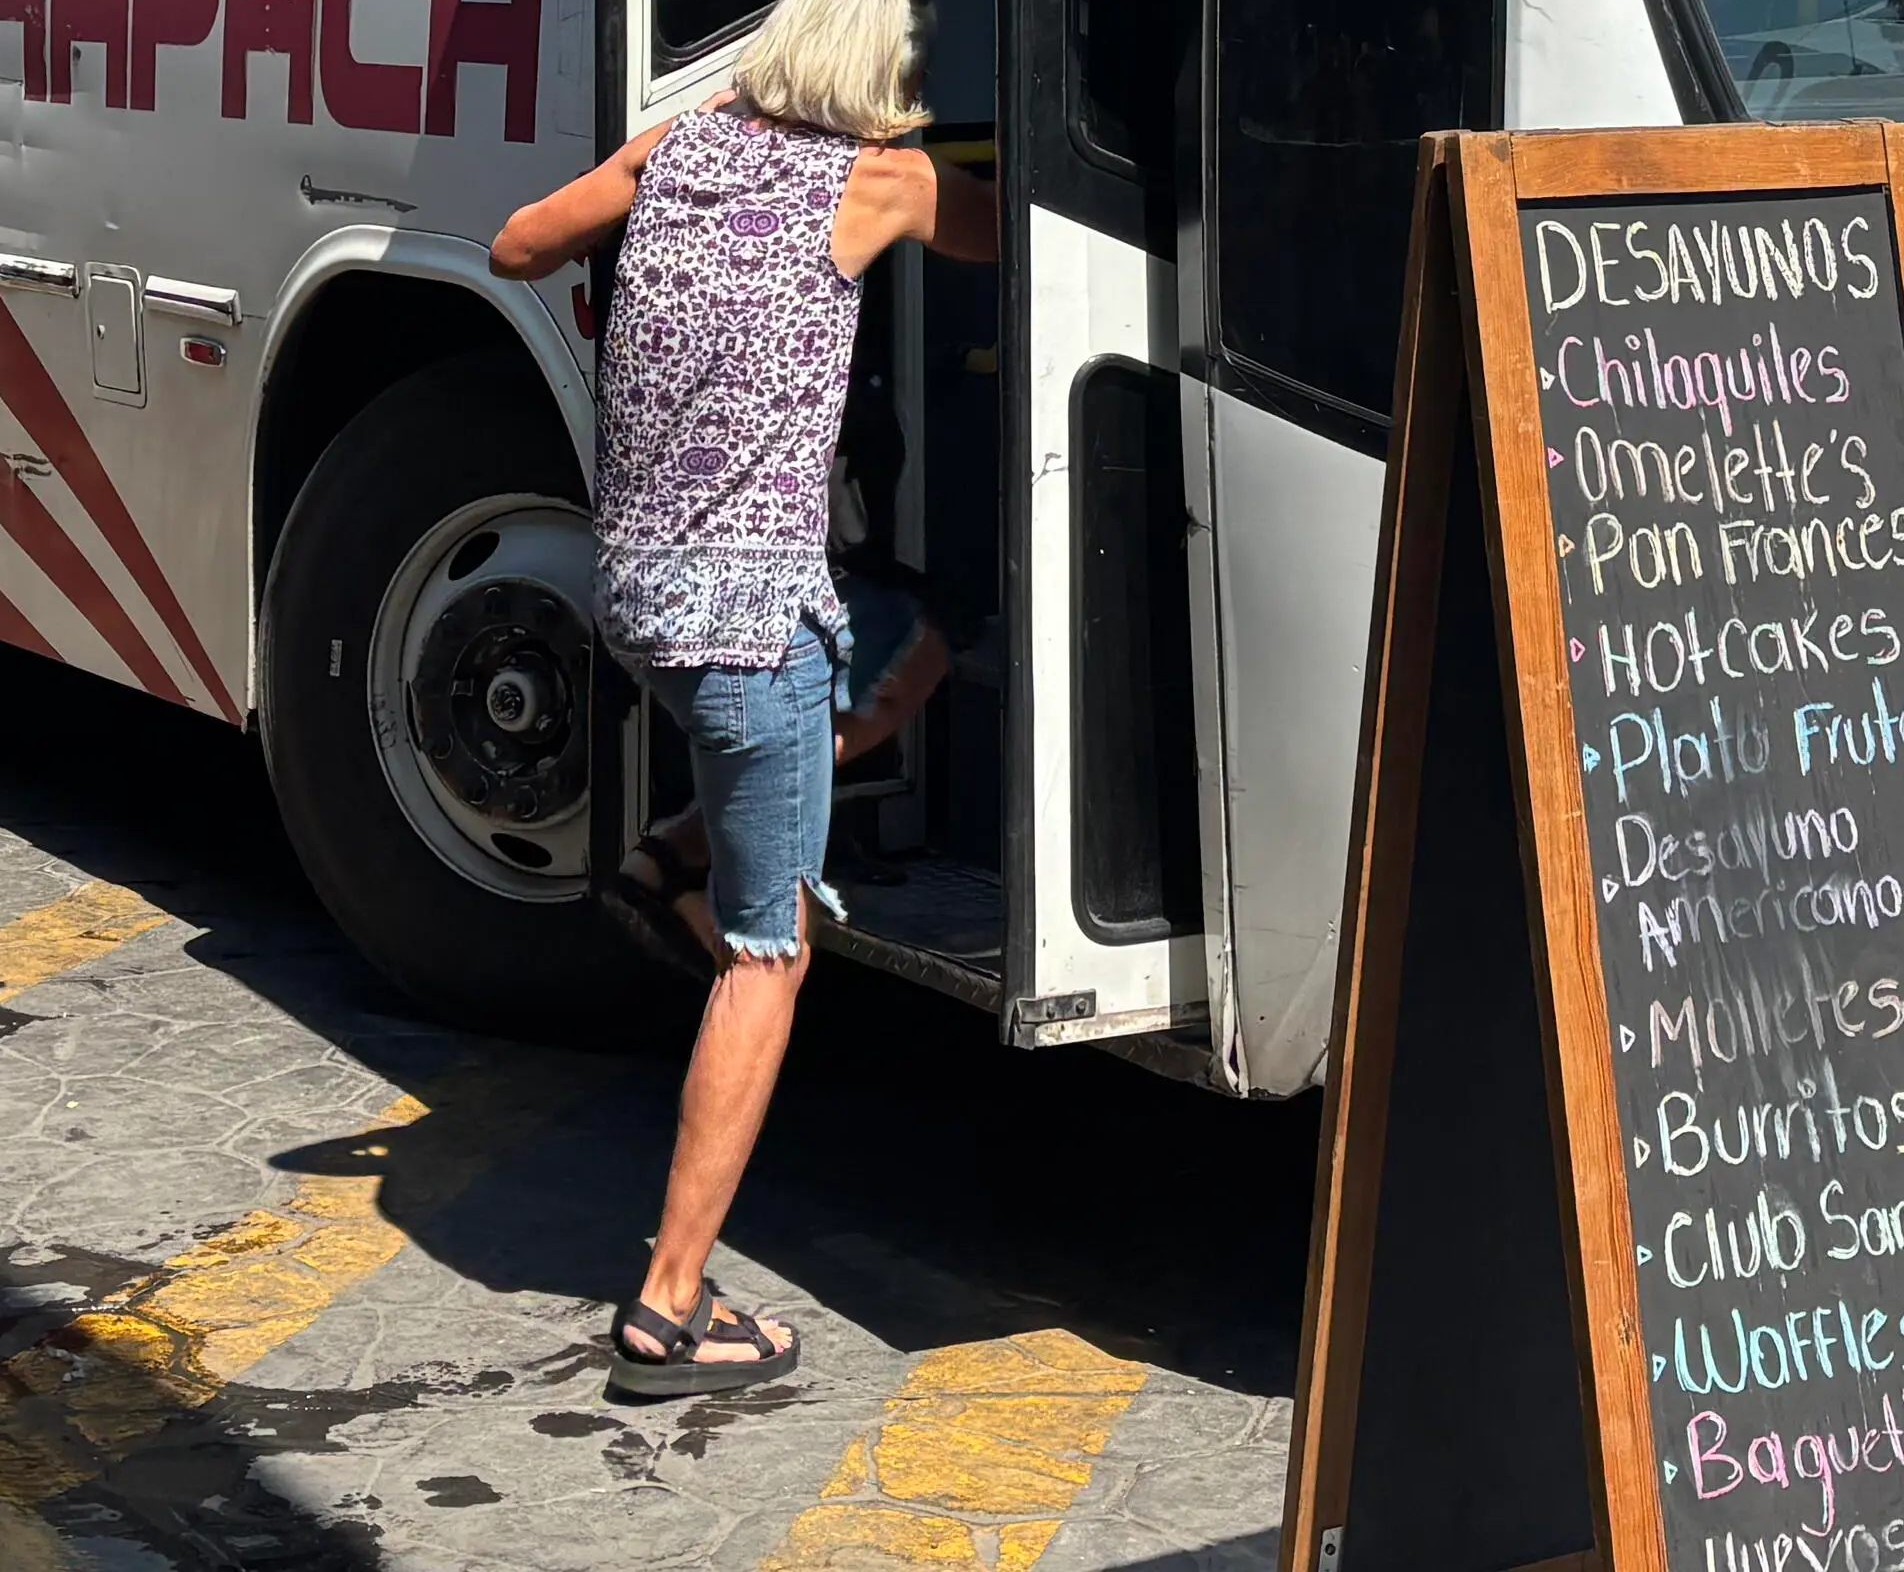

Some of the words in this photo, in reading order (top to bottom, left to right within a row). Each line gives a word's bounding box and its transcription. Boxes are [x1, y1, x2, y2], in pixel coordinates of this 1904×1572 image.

[1535, 216, 1880, 314] DESAYUNOS
[1558, 321, 1850, 437] Chilaquiles
[1575, 418, 1877, 513] Omelette's
[1585, 512, 1704, 596] Pan
[1610, 695, 1770, 804] Plato
[1617, 805, 1859, 889] Desayuno
[1637, 874, 1904, 972] Americano
[1664, 1192, 1806, 1289] Club
